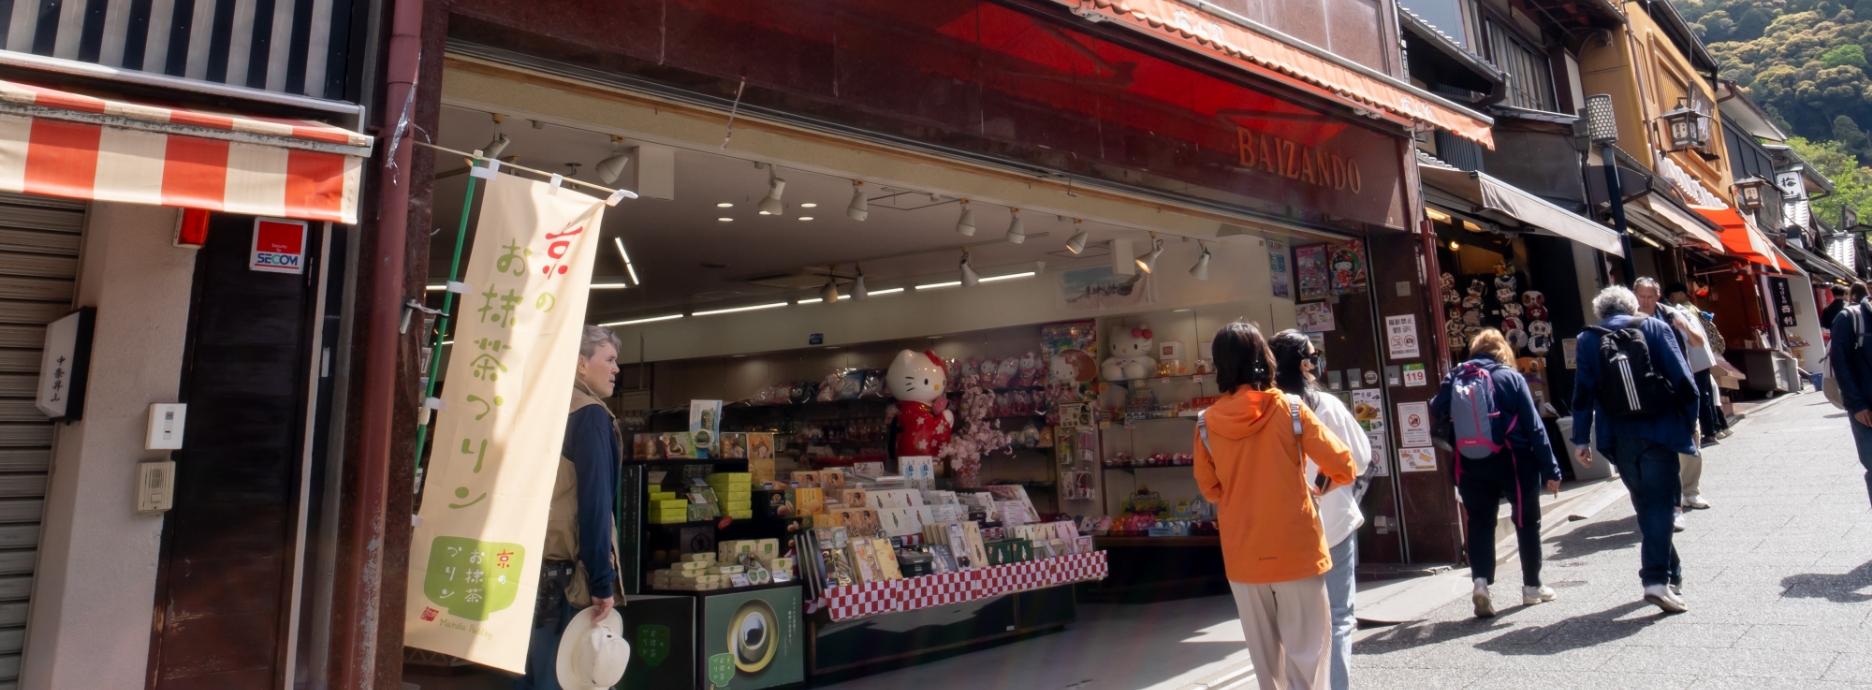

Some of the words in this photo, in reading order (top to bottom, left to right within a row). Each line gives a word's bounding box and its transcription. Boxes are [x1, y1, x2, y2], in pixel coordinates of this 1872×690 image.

[1236, 125, 1360, 194] BAIZANDO
[257, 253, 298, 266] SECOM
[1406, 371, 1424, 382] 119
[439, 546, 463, 599] プリン
[465, 549, 486, 603] お抹茶
[496, 549, 515, 585] 京の
